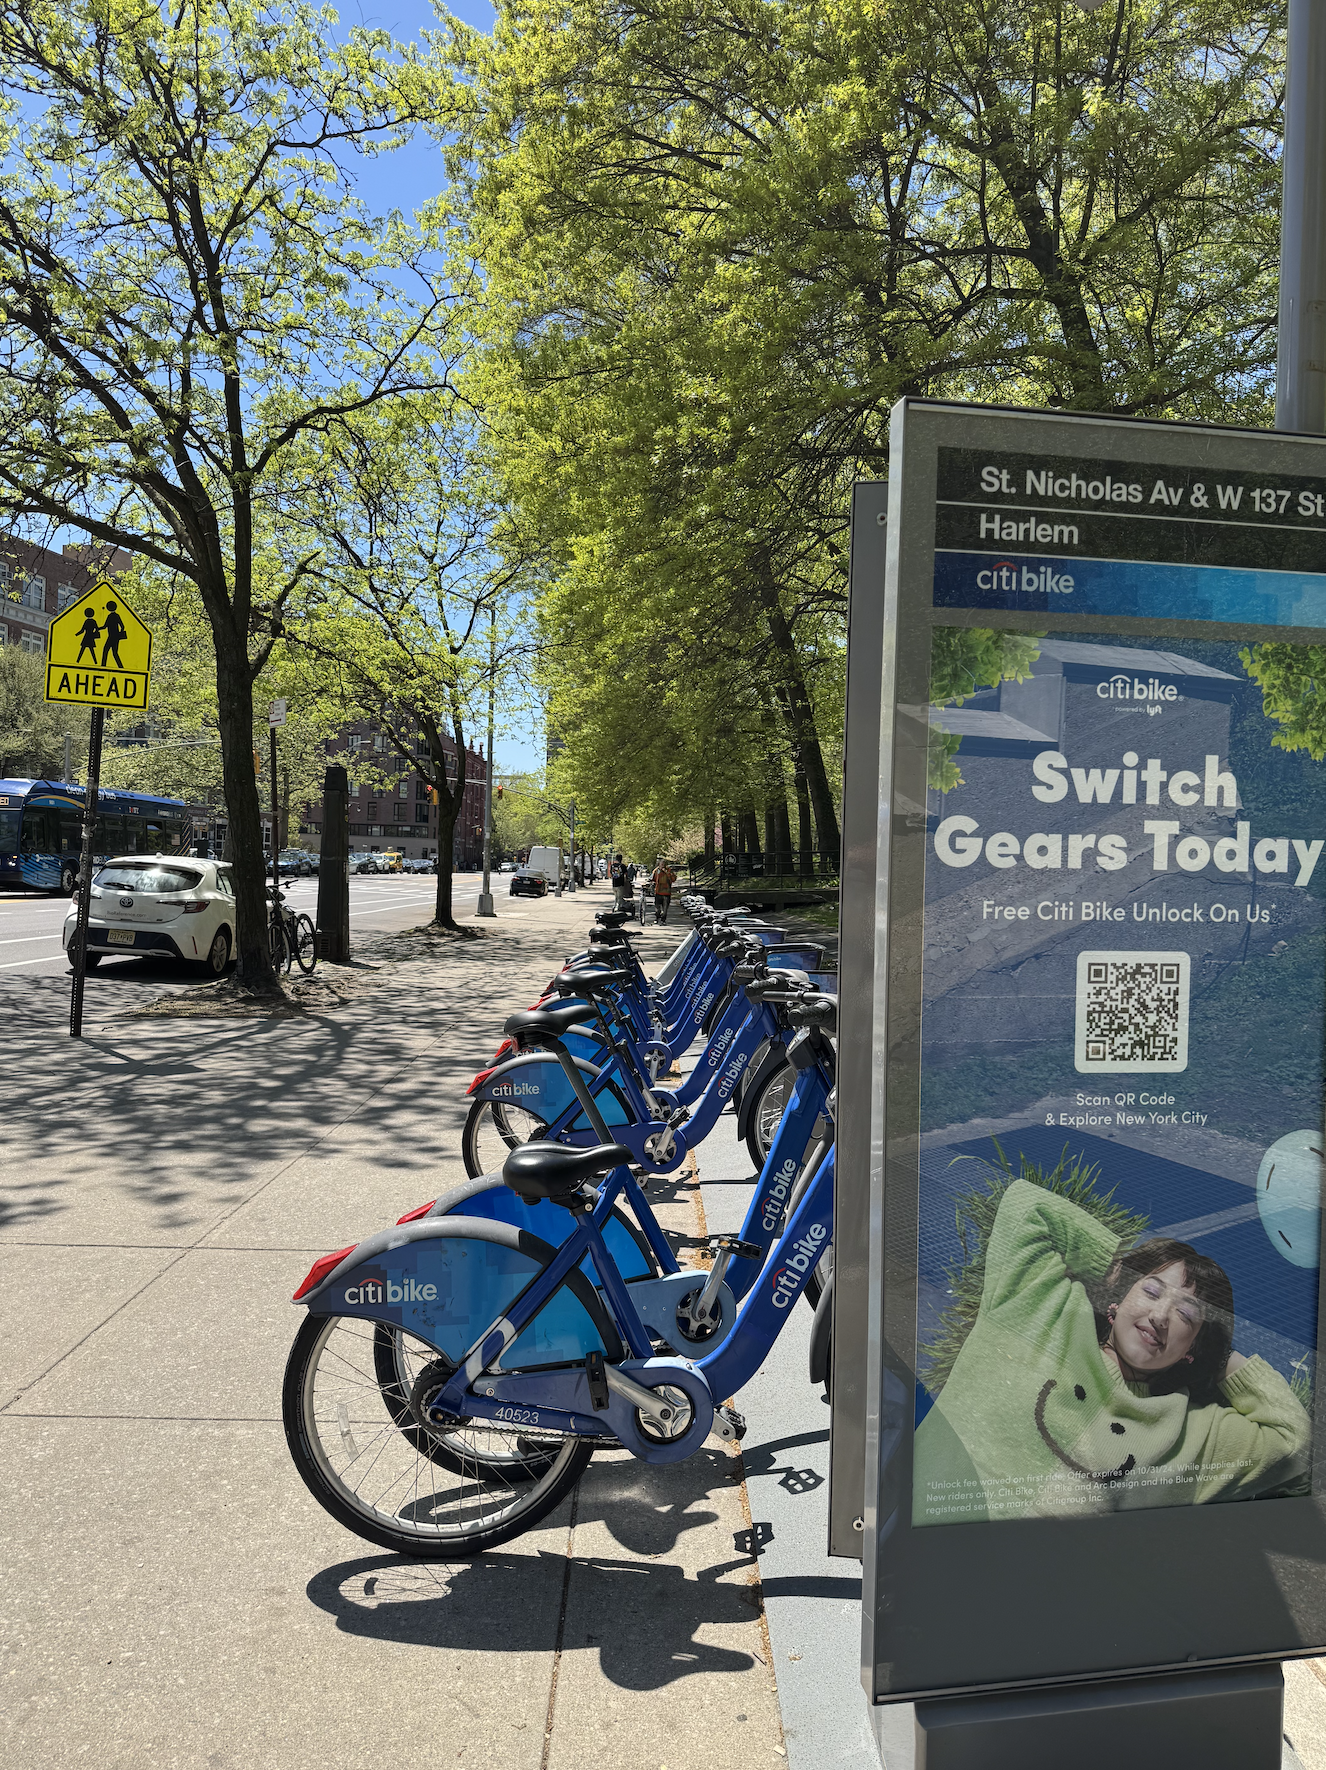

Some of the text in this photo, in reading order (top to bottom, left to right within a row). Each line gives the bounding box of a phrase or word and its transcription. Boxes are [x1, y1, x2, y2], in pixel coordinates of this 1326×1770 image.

[980, 466, 1325, 517] St. Nicholas Av & W 137 St
[979, 513, 1079, 545] Harlem
[57, 672, 137, 699] AHEAD
[1146, 704, 1162, 716] lyft
[1032, 750, 1238, 807] Switch
[933, 815, 1325, 887] Gears Today
[982, 901, 1030, 921] Free
[1037, 901, 1074, 921] Citi
[1081, 902, 1126, 922] Bike
[1133, 903, 1204, 923] Unlock
[1209, 903, 1240, 923] On
[1076, 1092, 1175, 1107] Scan QR Code
[1045, 1111, 1208, 1128] & Explore New York City
[495, 1407, 540, 1424] 40523
[963, 1479, 977, 1487] fee
[980, 1476, 1011, 1486] waived
[1027, 1474, 1043, 1482] first
[1067, 1470, 1090, 1480] Offer
[1092, 1469, 1122, 1479] expires
[1177, 1463, 1200, 1472] While
[1202, 1460, 1235, 1470] supplies
[1237, 1459, 1254, 1467] last.
[926, 1493, 946, 1502] New
[948, 1492, 973, 1500] riders
[976, 1490, 996, 1499] only.
[998, 1487, 1013, 1496] Citi
[1038, 1485, 1052, 1494] Citi
[1054, 1484, 1072, 1493] Bike
[1074, 1482, 1092, 1491] and
[1093, 1481, 1108, 1490] Arc
[1110, 1479, 1139, 1489] Design
[1141, 1478, 1158, 1487] and
[1160, 1477, 1174, 1485] the
[1175, 1475, 1194, 1484] Blue
[1195, 1473, 1218, 1482] Wave
[926, 1494, 1104, 1515] registered service marks of Citigroup Inc.
